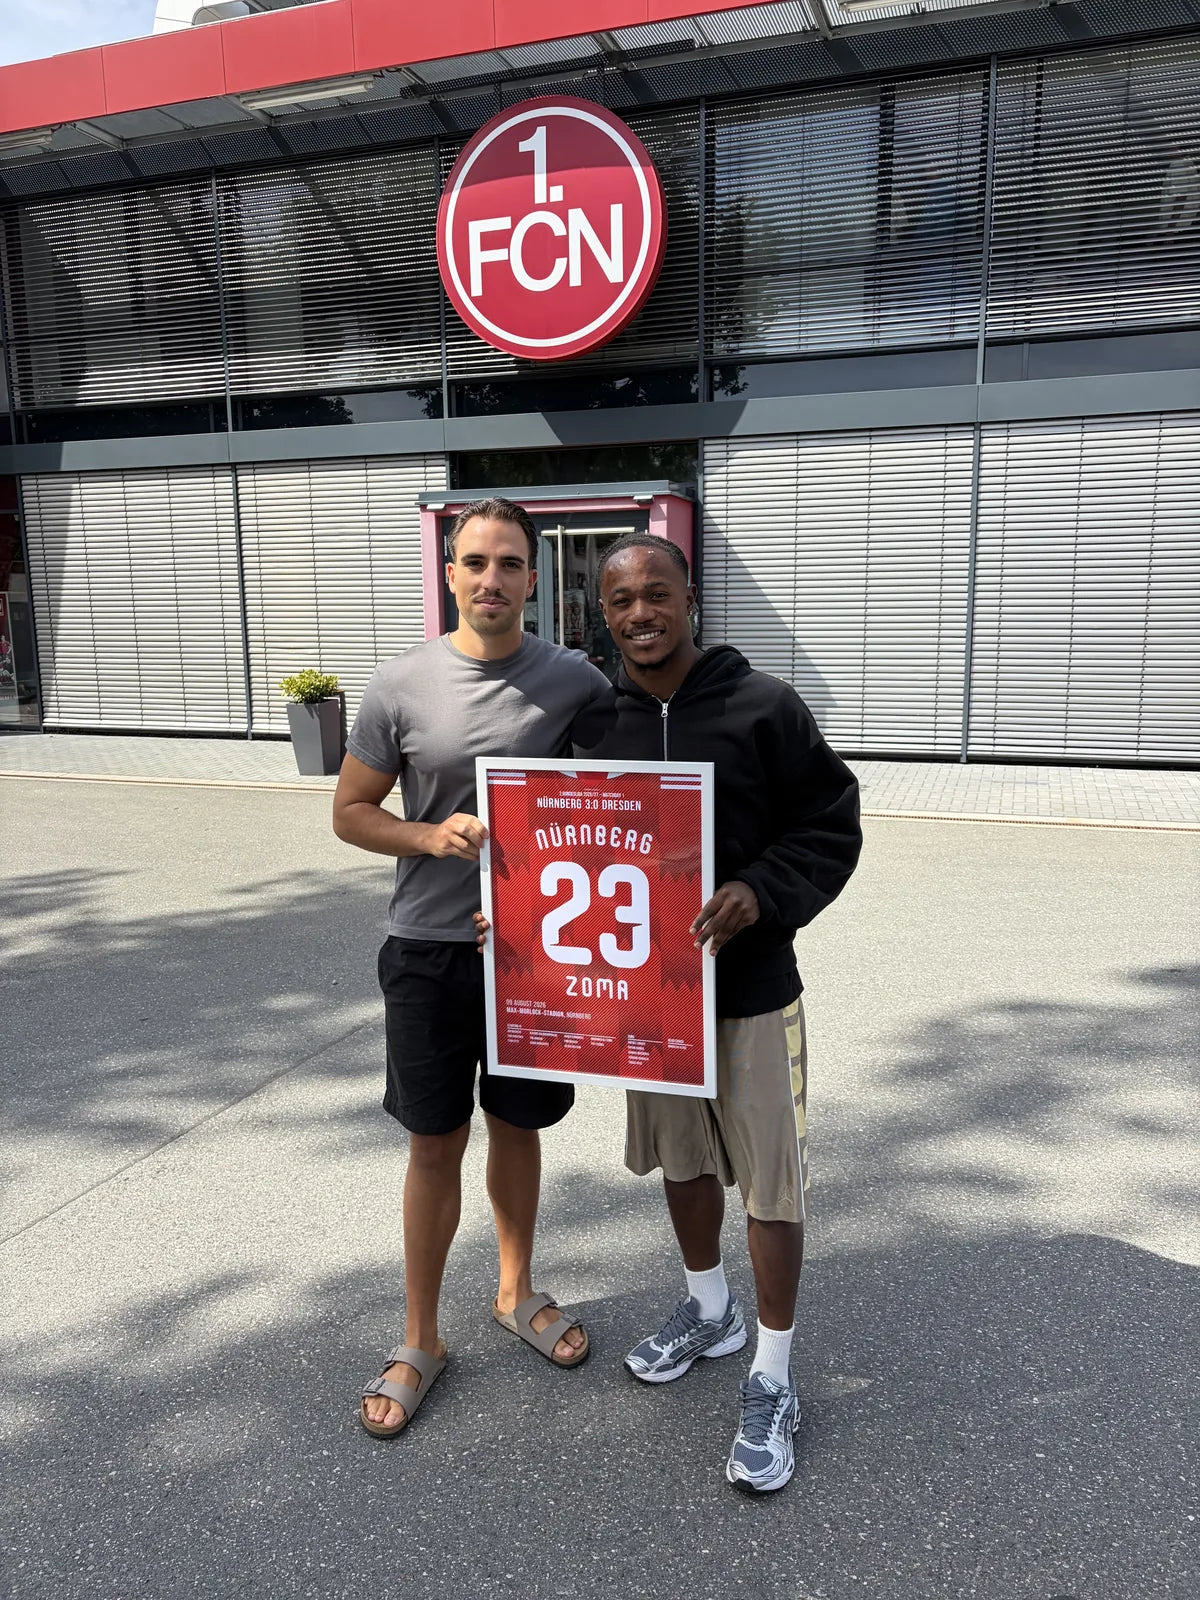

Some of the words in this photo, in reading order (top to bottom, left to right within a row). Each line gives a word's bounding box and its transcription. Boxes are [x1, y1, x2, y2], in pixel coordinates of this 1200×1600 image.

[519, 126, 564, 204] 1.
[468, 203, 624, 297] FCN
[537, 795, 582, 809] NÜRNBERG
[585, 799, 599, 810] 3:0
[601, 800, 641, 811] DRESDEN
[535, 822, 653, 855] NÜRNBERG
[540, 861, 651, 969] 23
[565, 975, 629, 1001] ZOMA
